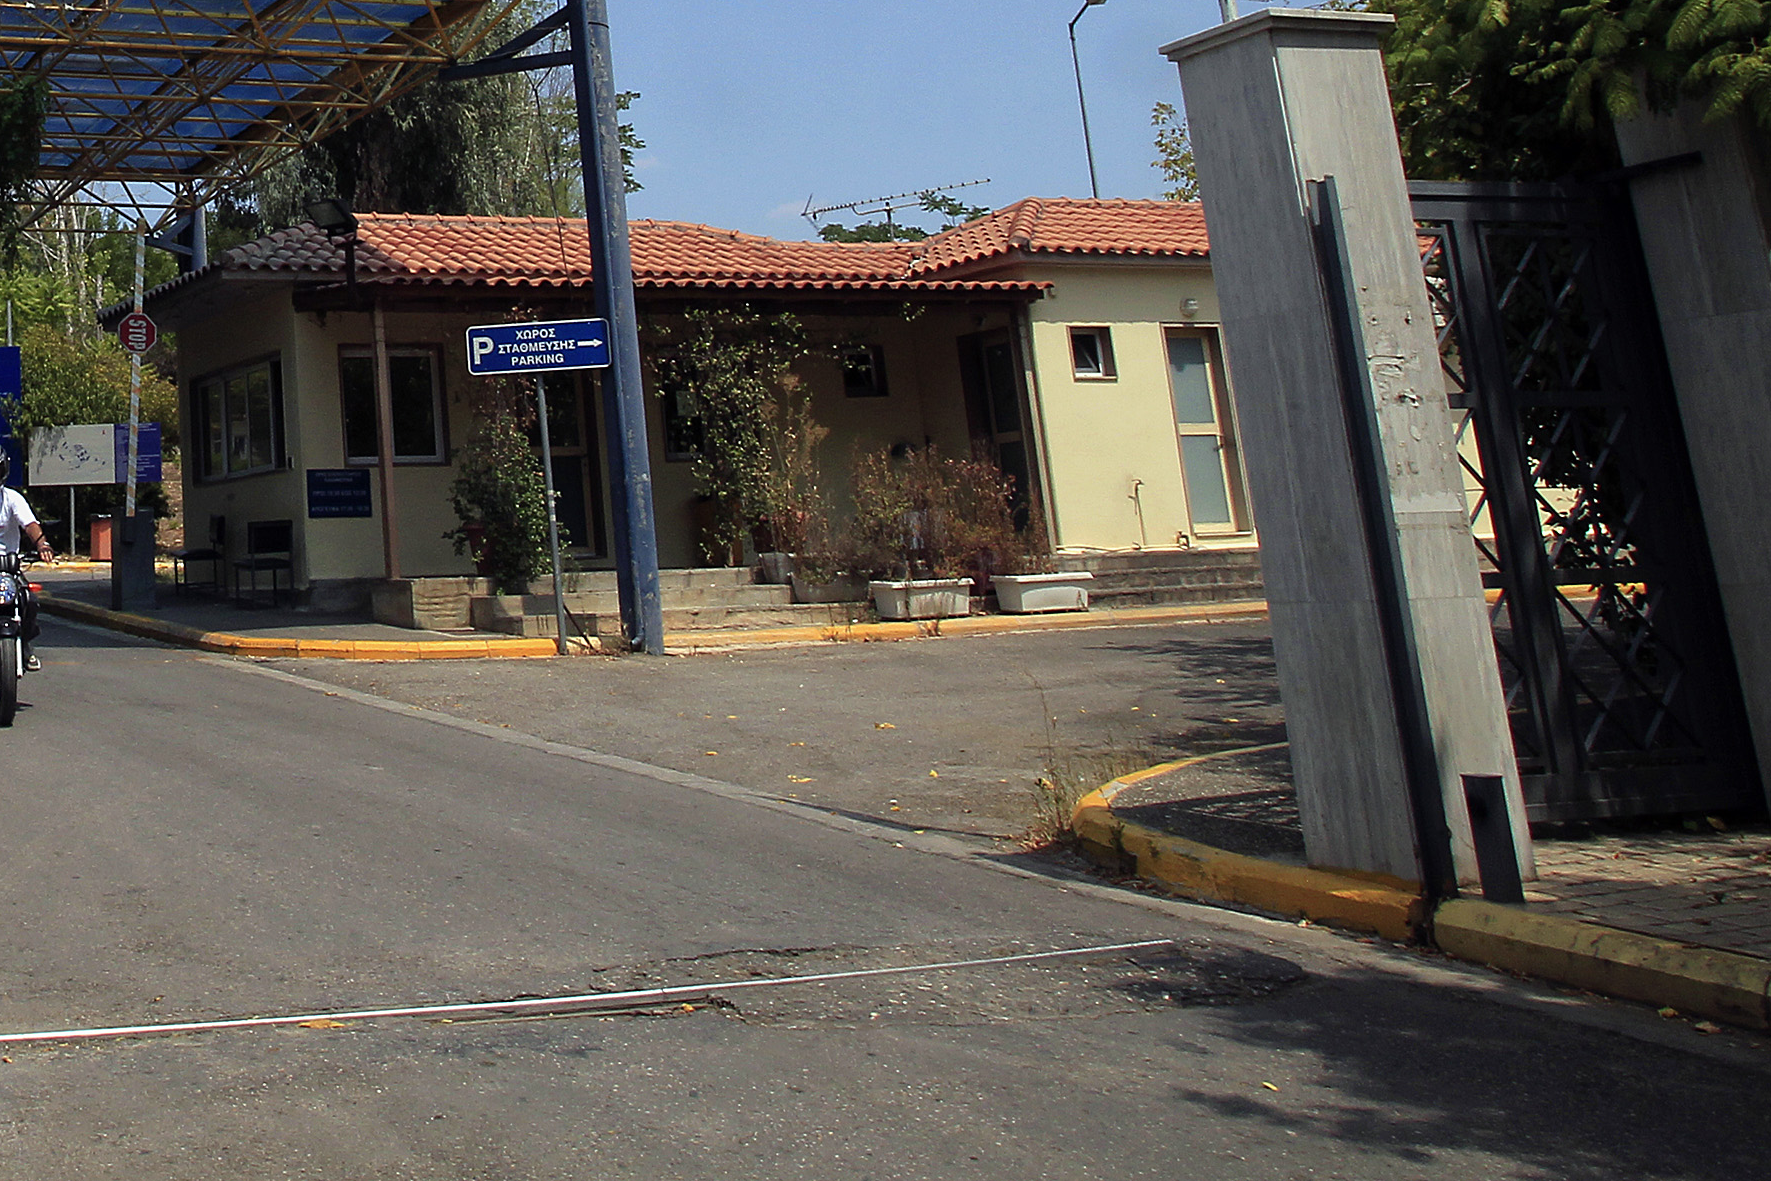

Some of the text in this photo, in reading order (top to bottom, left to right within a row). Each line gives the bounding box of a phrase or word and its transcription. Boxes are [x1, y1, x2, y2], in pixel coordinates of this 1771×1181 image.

[128, 319, 147, 350] STOP
[516, 328, 556, 339] ΧΩΡΟΣ
[472, 336, 494, 364] P
[498, 340, 576, 354] ΣΤΑΘΜΕΥΣΗΣ
[511, 354, 564, 366] PARKING
